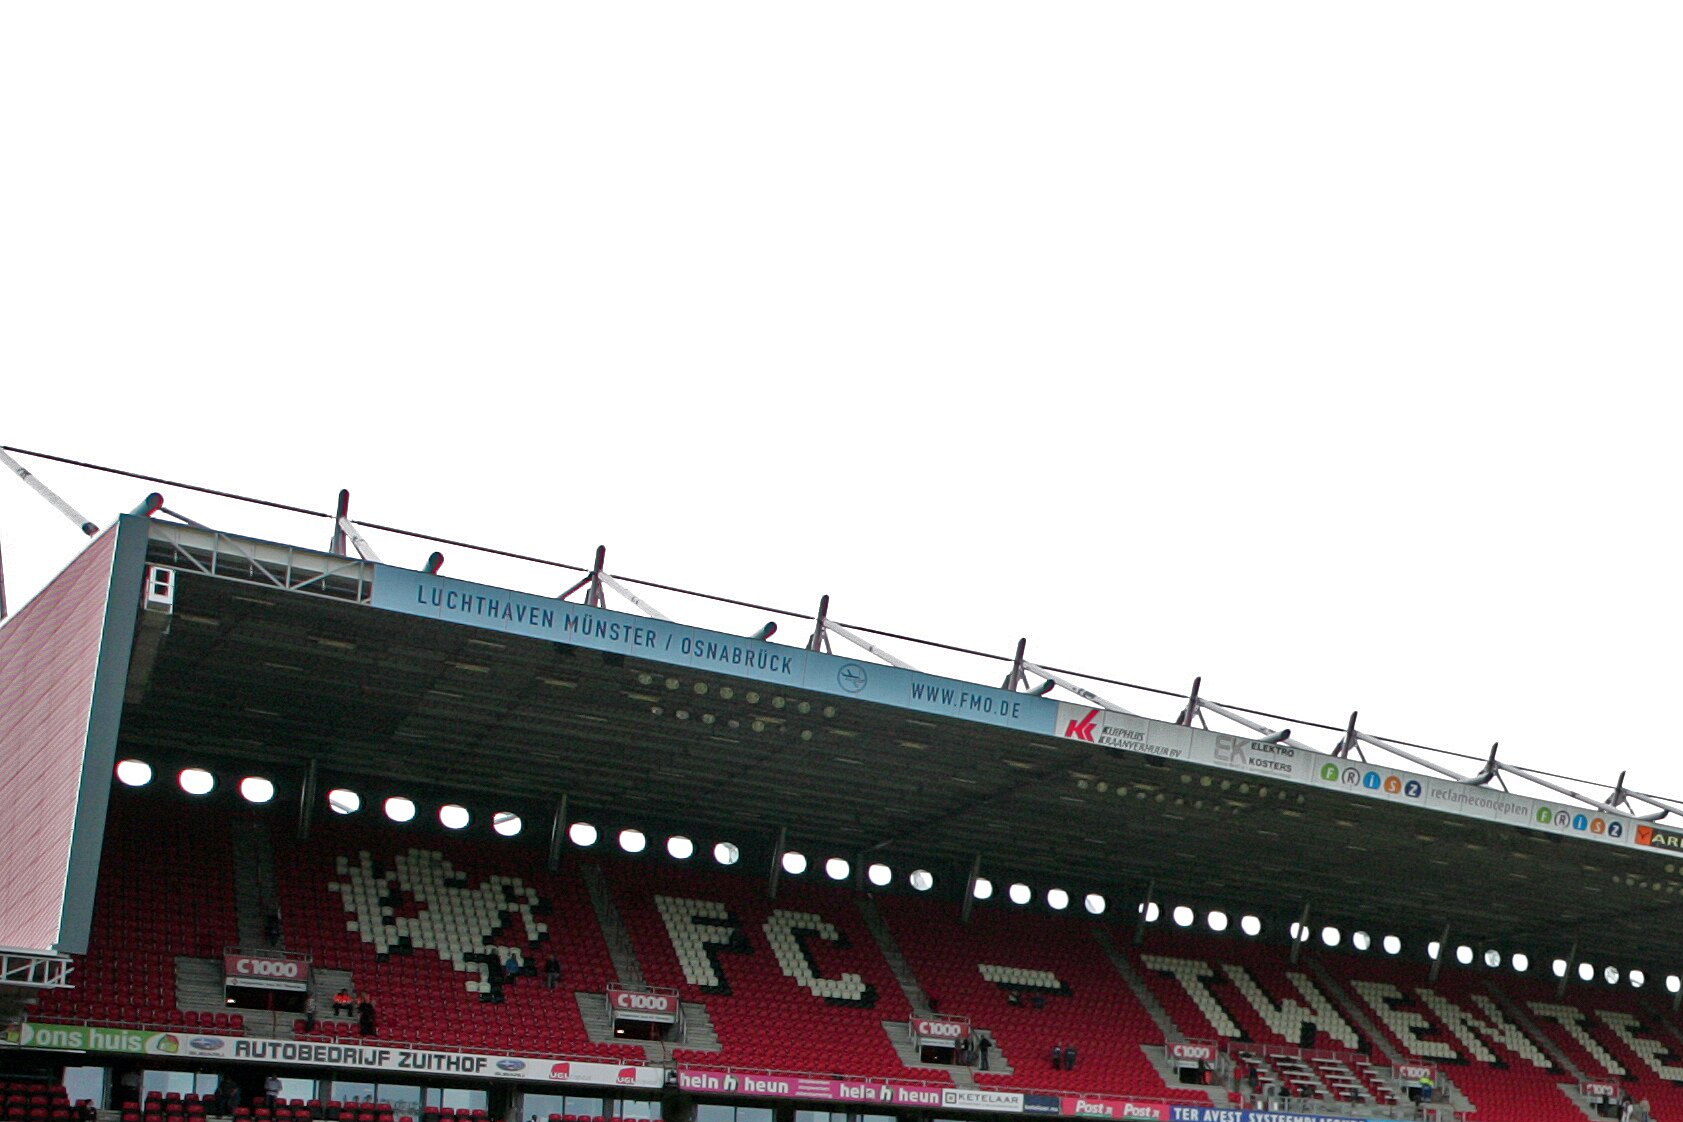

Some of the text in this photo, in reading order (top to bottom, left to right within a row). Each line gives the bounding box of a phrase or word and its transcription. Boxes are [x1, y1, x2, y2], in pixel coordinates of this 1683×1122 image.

[417, 585, 793, 676] LUCHTHAVEN MÜNSTER / OSNABRÜCK
[911, 682, 1021, 720] WWW.FMO.DE
[1251, 742, 1295, 758] ELEKTRO
[1249, 757, 1292, 773] KOSTERS
[1431, 787, 1529, 817] reclameconcepten
[236, 959, 298, 979] C1000
[617, 993, 669, 1012] C1000
[37, 1026, 143, 1051] ons huis
[918, 1021, 962, 1038] C1000
[235, 1040, 488, 1073] AUTOBEDRIJF ZUITHOF
[1173, 1043, 1211, 1060] C1000
[680, 1072, 719, 1090] hein
[744, 1078, 789, 1094] heun
[899, 1088, 940, 1104] heun
[958, 1092, 1020, 1105] KETELAAR
[1075, 1100, 1151, 1117] Post Post
[1174, 1107, 1199, 1122] TER
